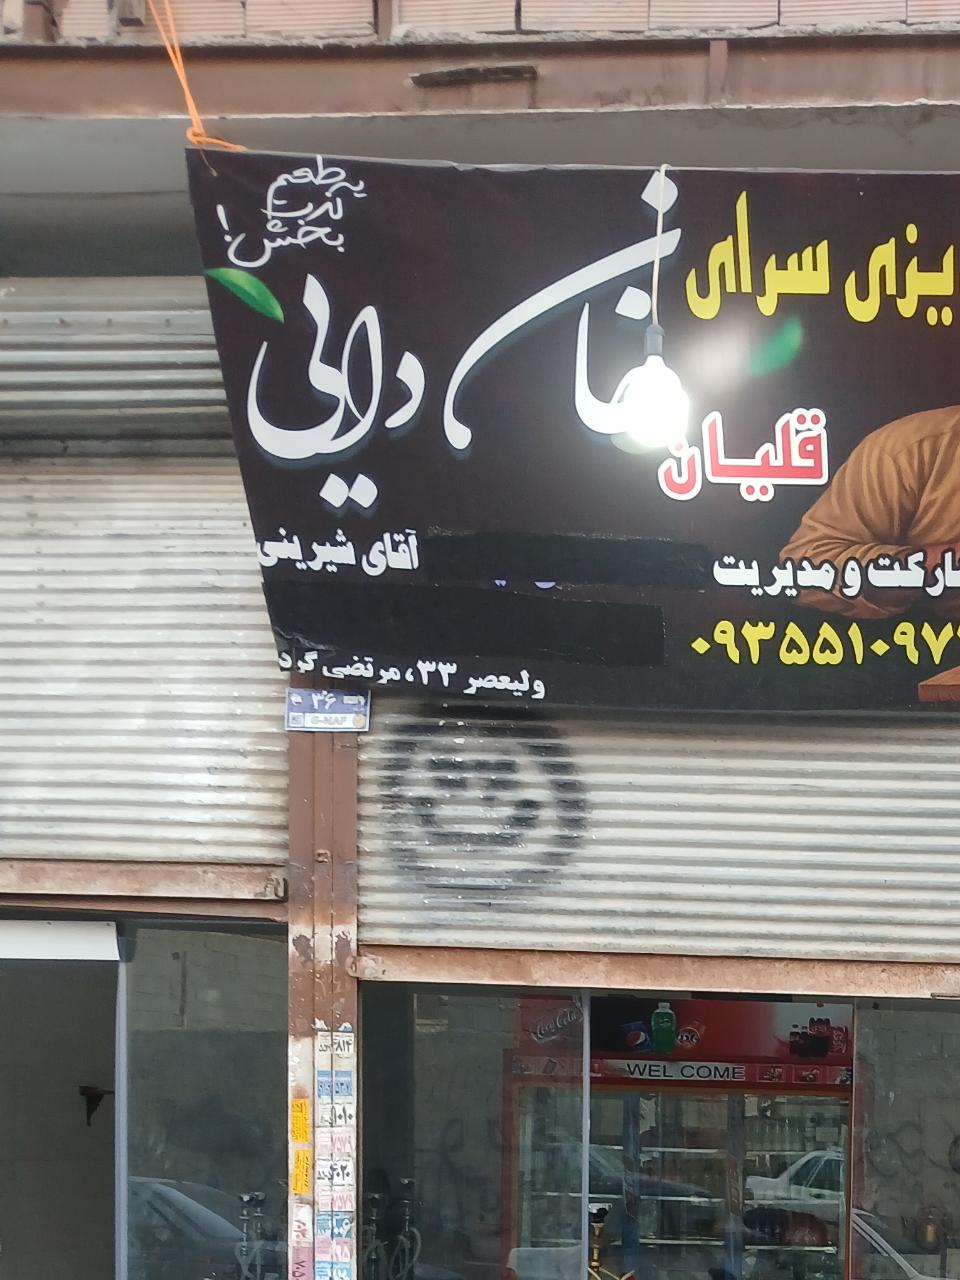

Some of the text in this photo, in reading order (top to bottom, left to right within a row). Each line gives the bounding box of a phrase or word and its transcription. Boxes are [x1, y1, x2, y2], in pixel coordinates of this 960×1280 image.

[684, 190, 831, 320] سرای
[657, 407, 830, 502] قلیان
[255, 526, 420, 577] آقای شیرینی
[712, 552, 836, 597] مدیریت
[841, 562, 862, 596] و
[321, 655, 402, 685] مرتضی
[463, 669, 546, 700] ولیعصر
